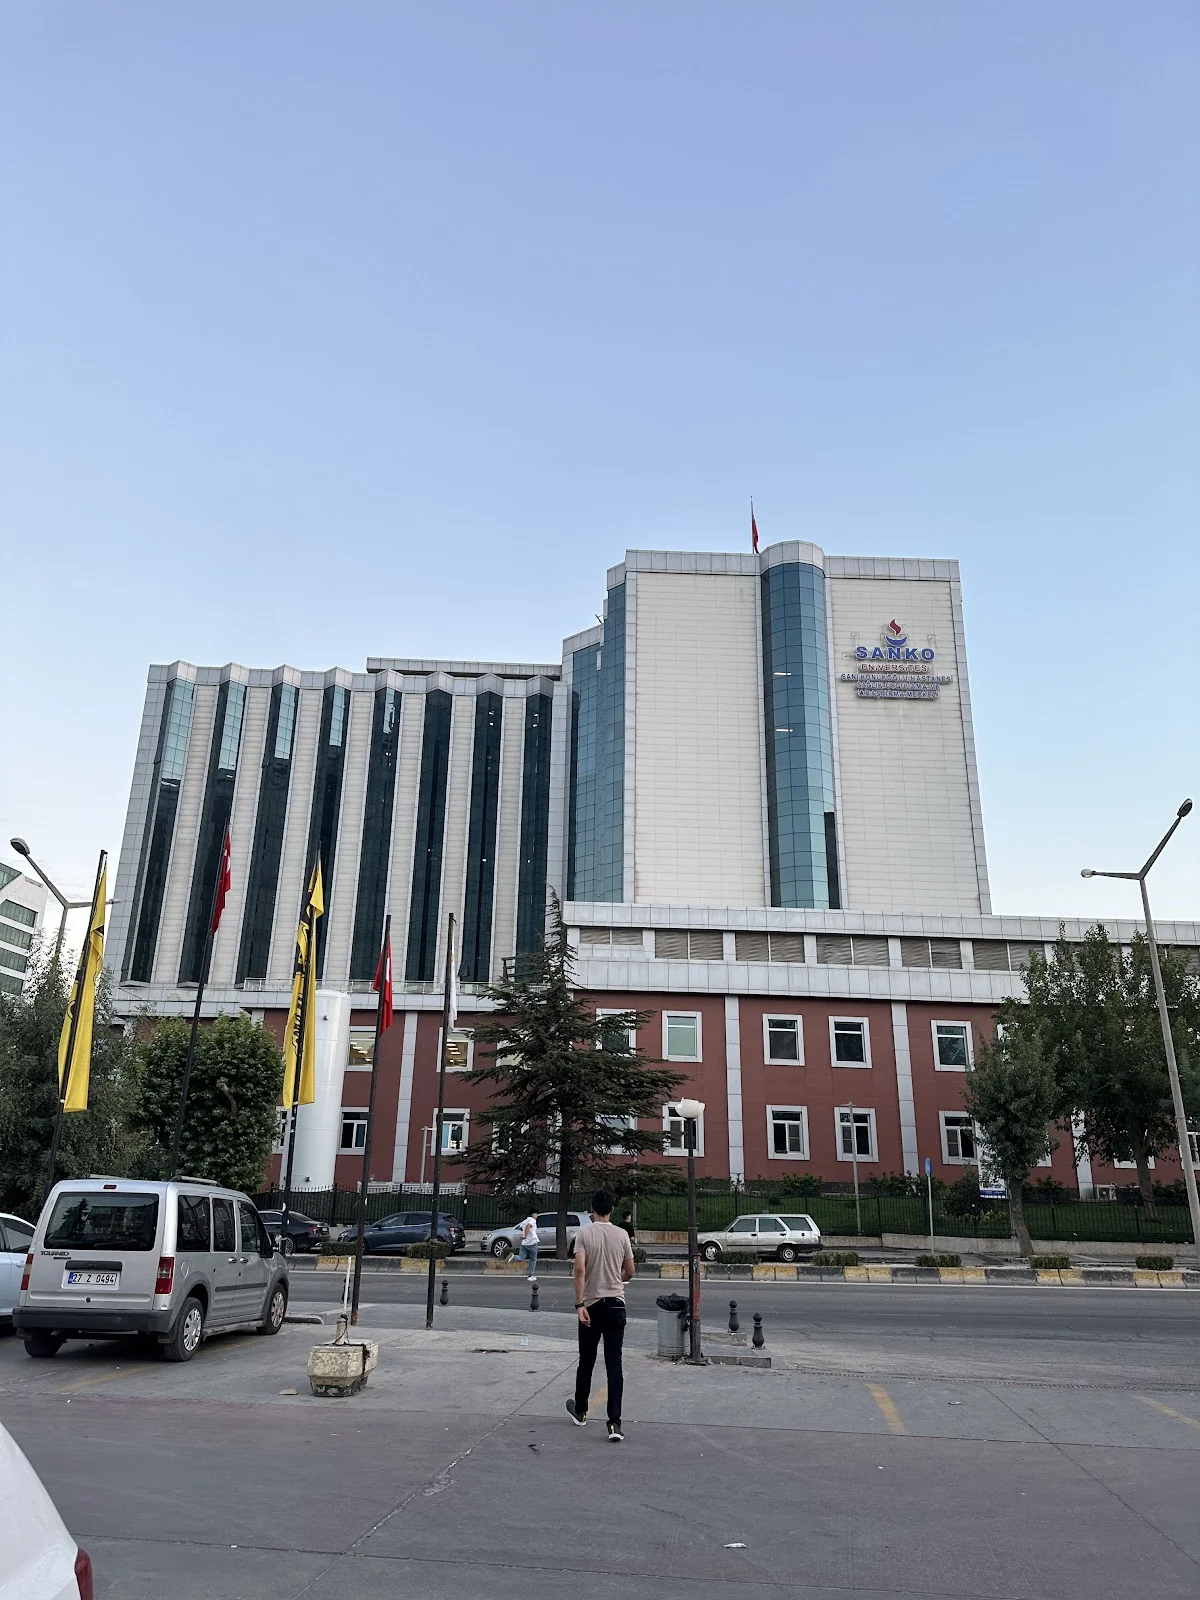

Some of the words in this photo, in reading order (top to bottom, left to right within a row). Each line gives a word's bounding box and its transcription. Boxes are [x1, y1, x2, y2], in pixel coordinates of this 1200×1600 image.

[855, 646, 936, 661] SANKO
[73, 1273, 82, 1282] 27
[86, 1274, 92, 1283] Z
[95, 1275, 114, 1283] 0494
